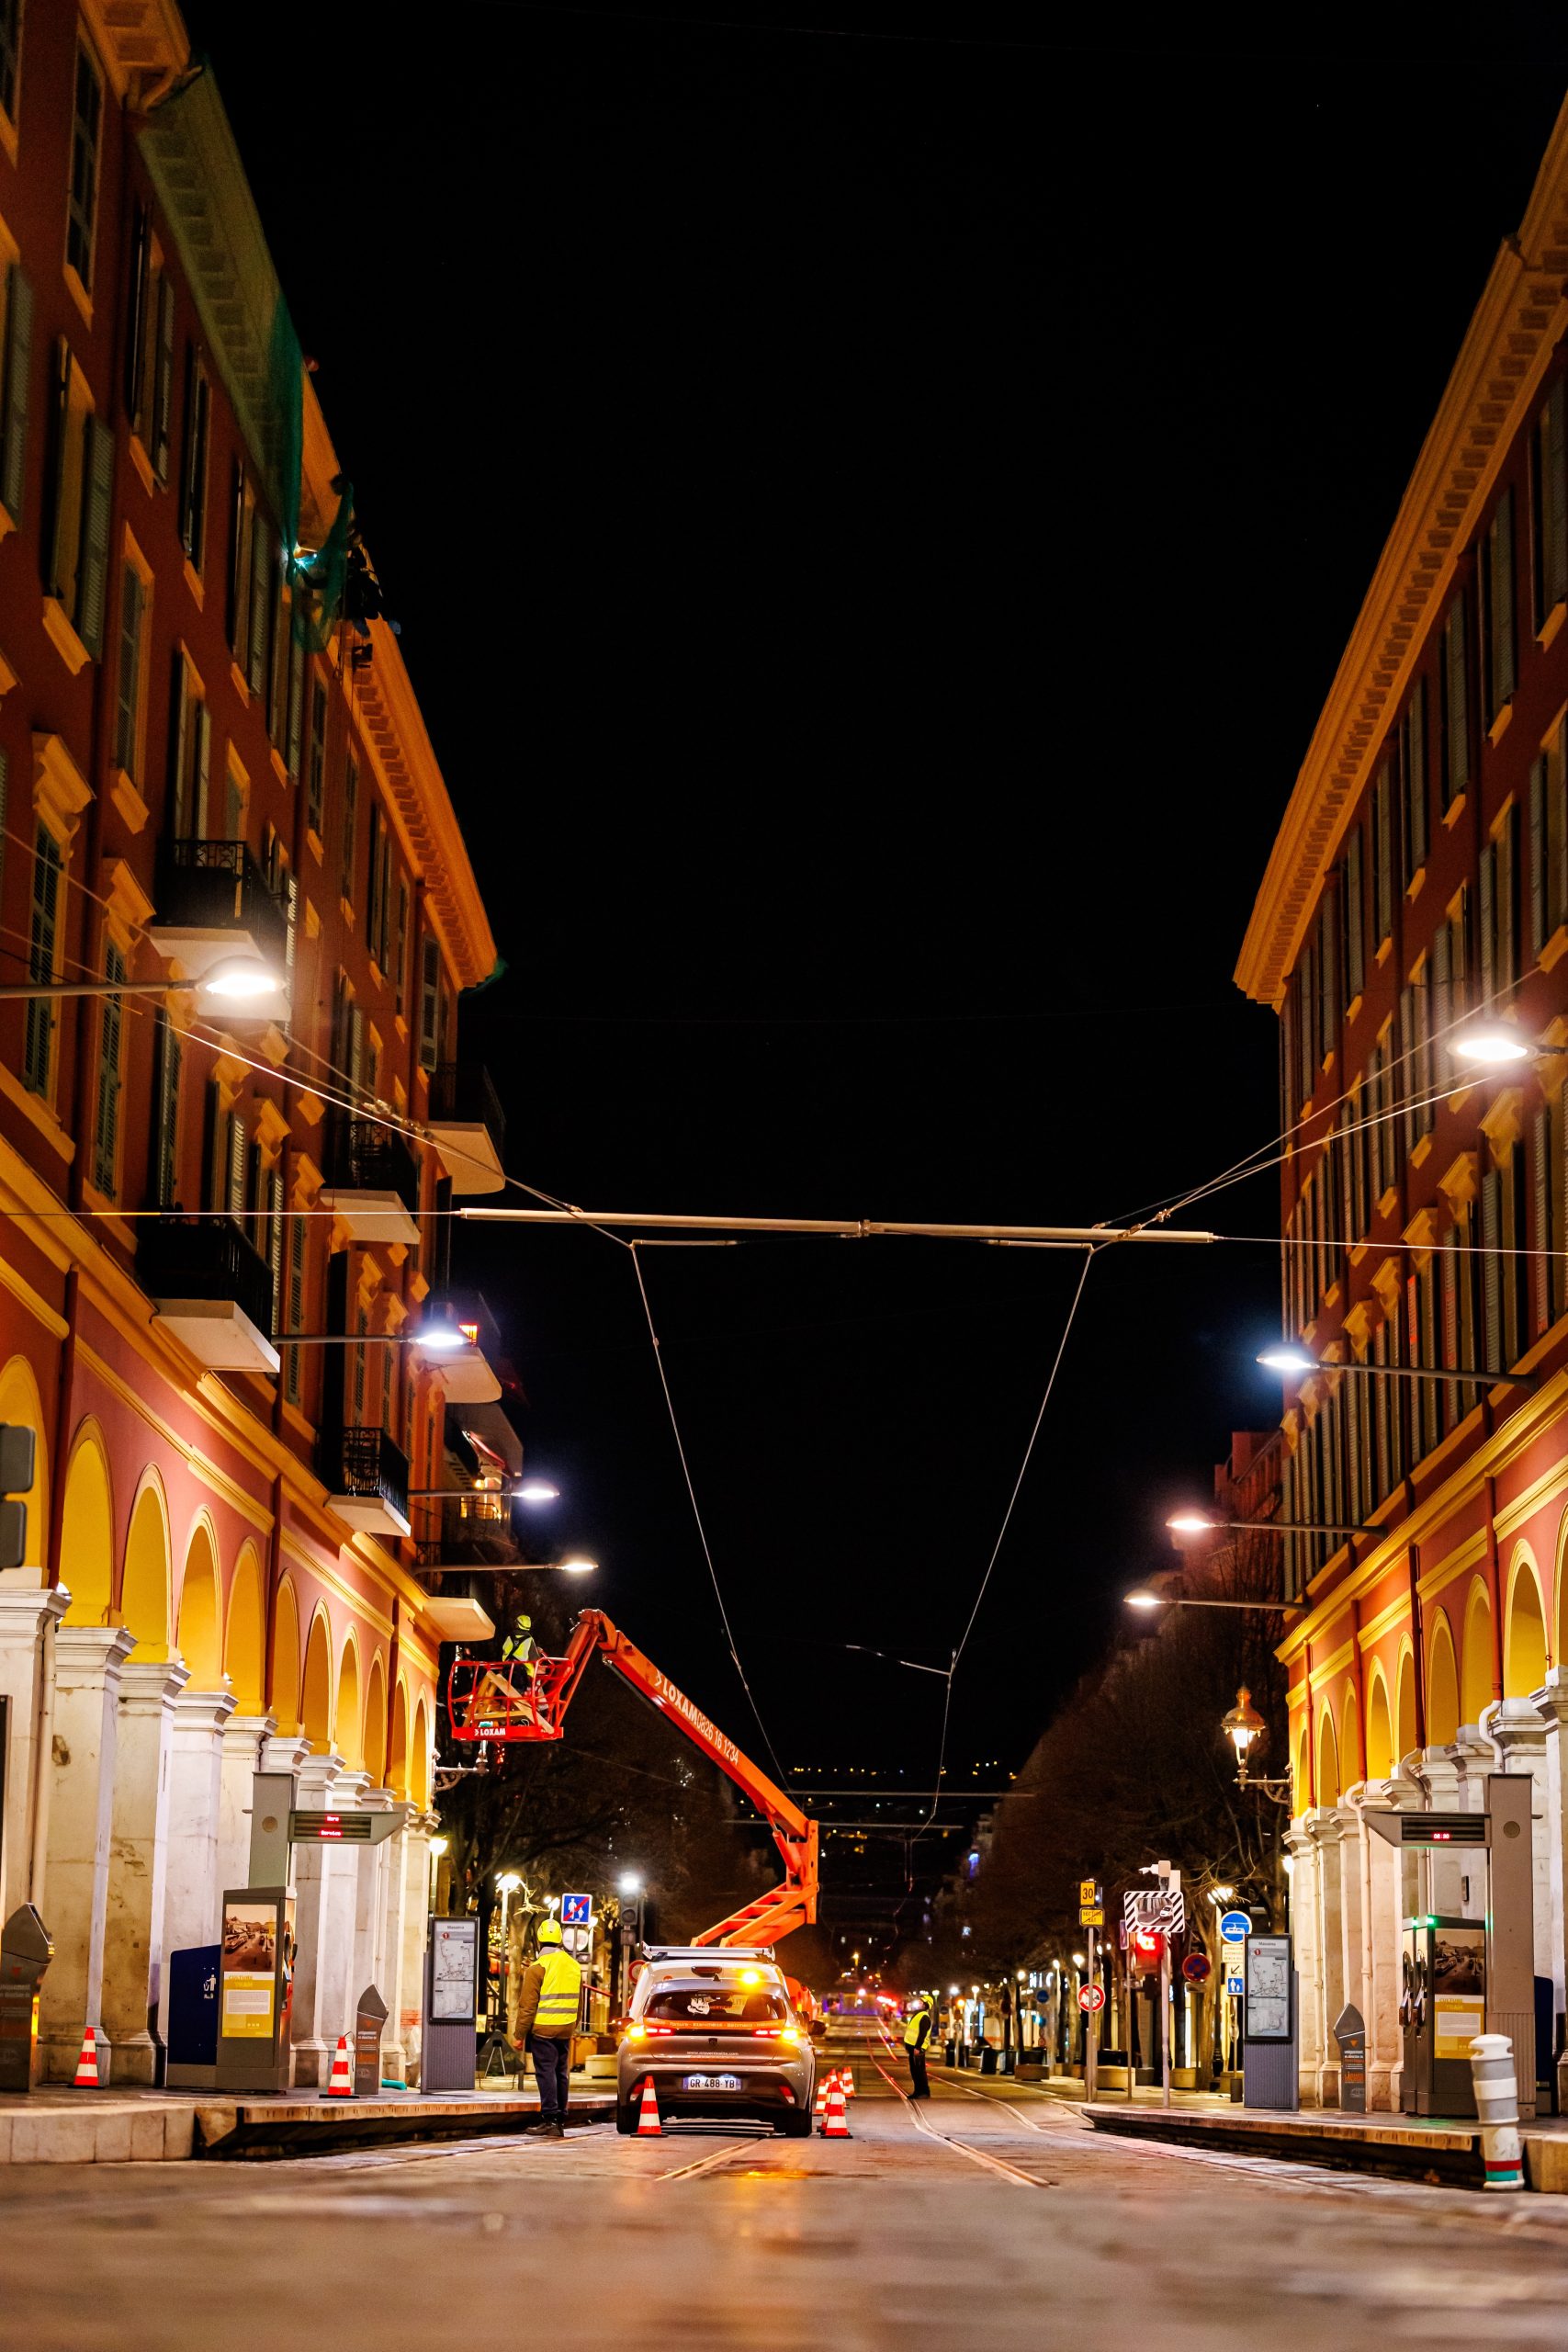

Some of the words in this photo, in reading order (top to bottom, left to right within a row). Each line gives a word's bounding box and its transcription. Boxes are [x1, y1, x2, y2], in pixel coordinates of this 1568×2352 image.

[662, 1677, 700, 1724] LOXAM
[696, 1712, 715, 1740] 0826
[715, 1729, 723, 1749] 16
[723, 1739, 739, 1765] 1234
[1082, 1887, 1093, 1899] 30
[690, 2078, 735, 2088] GR-488-YB
